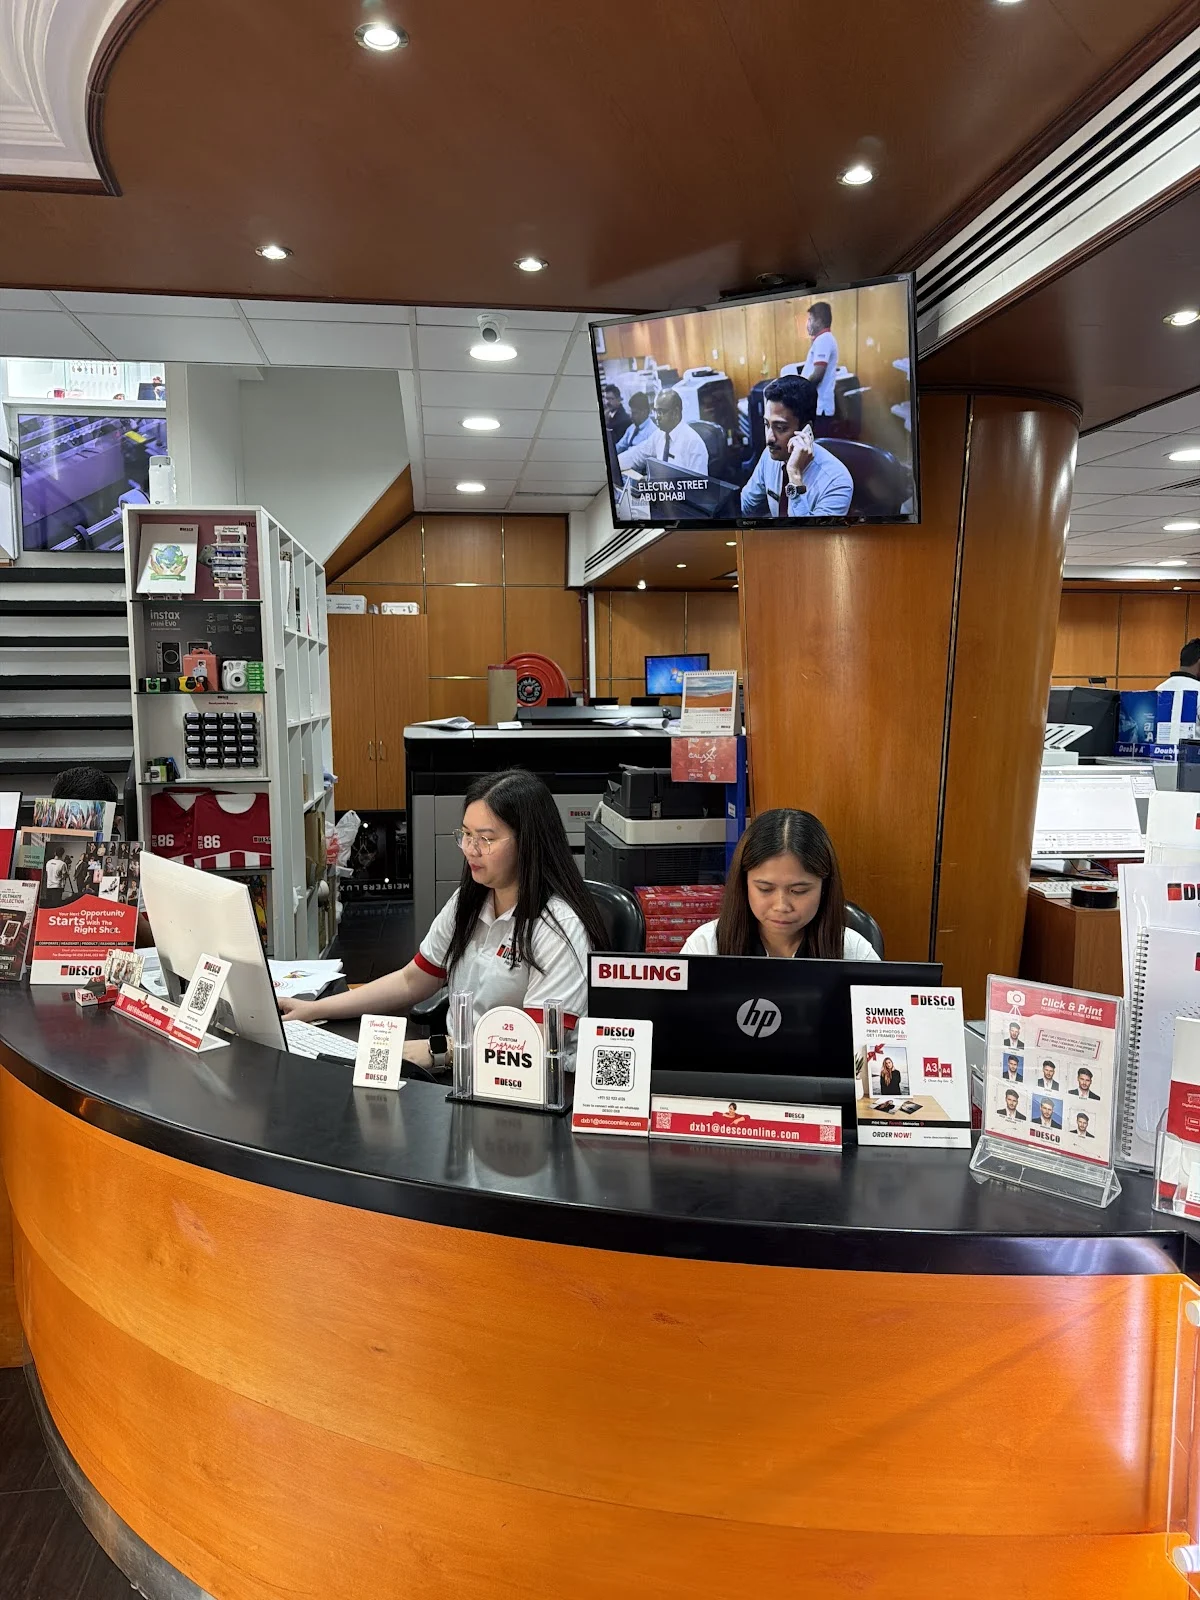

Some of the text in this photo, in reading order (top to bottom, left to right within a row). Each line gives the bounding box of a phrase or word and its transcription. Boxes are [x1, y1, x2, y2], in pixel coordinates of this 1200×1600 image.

[638, 479, 708, 492] ELECTRA STREET
[640, 492, 686, 501] ABU DHABI
[150, 609, 180, 620] instax
[1118, 744, 1138, 753] Doube
[158, 834, 174, 847] 86
[203, 835, 221, 849] 86
[363, 883, 410, 891] MEISTERS
[80, 909, 126, 920] Opportunity
[48, 915, 85, 926] Starts
[73, 925, 97, 935] Right
[68, 965, 102, 976] DESCO
[598, 963, 681, 982] BILLING
[920, 995, 956, 1007] DESCO
[1041, 997, 1103, 1016] Click & Print
[865, 1007, 904, 1017] SUMMER
[740, 998, 779, 1038] hp
[865, 1016, 906, 1025] SAVINGS
[387, 1021, 398, 1031] You
[604, 1026, 635, 1038] DESCO
[373, 1034, 390, 1042] Google
[487, 1035, 527, 1054] Engraved
[484, 1048, 533, 1069] PENS
[925, 1063, 938, 1073] A3
[369, 1073, 388, 1082] DESCO
[500, 1078, 522, 1088] DESCO
[580, 1117, 642, 1128] dxb1@descoonline.com
[689, 1121, 800, 1140] dxb1@descoonline.com
[1035, 1130, 1061, 1143] DESCO
